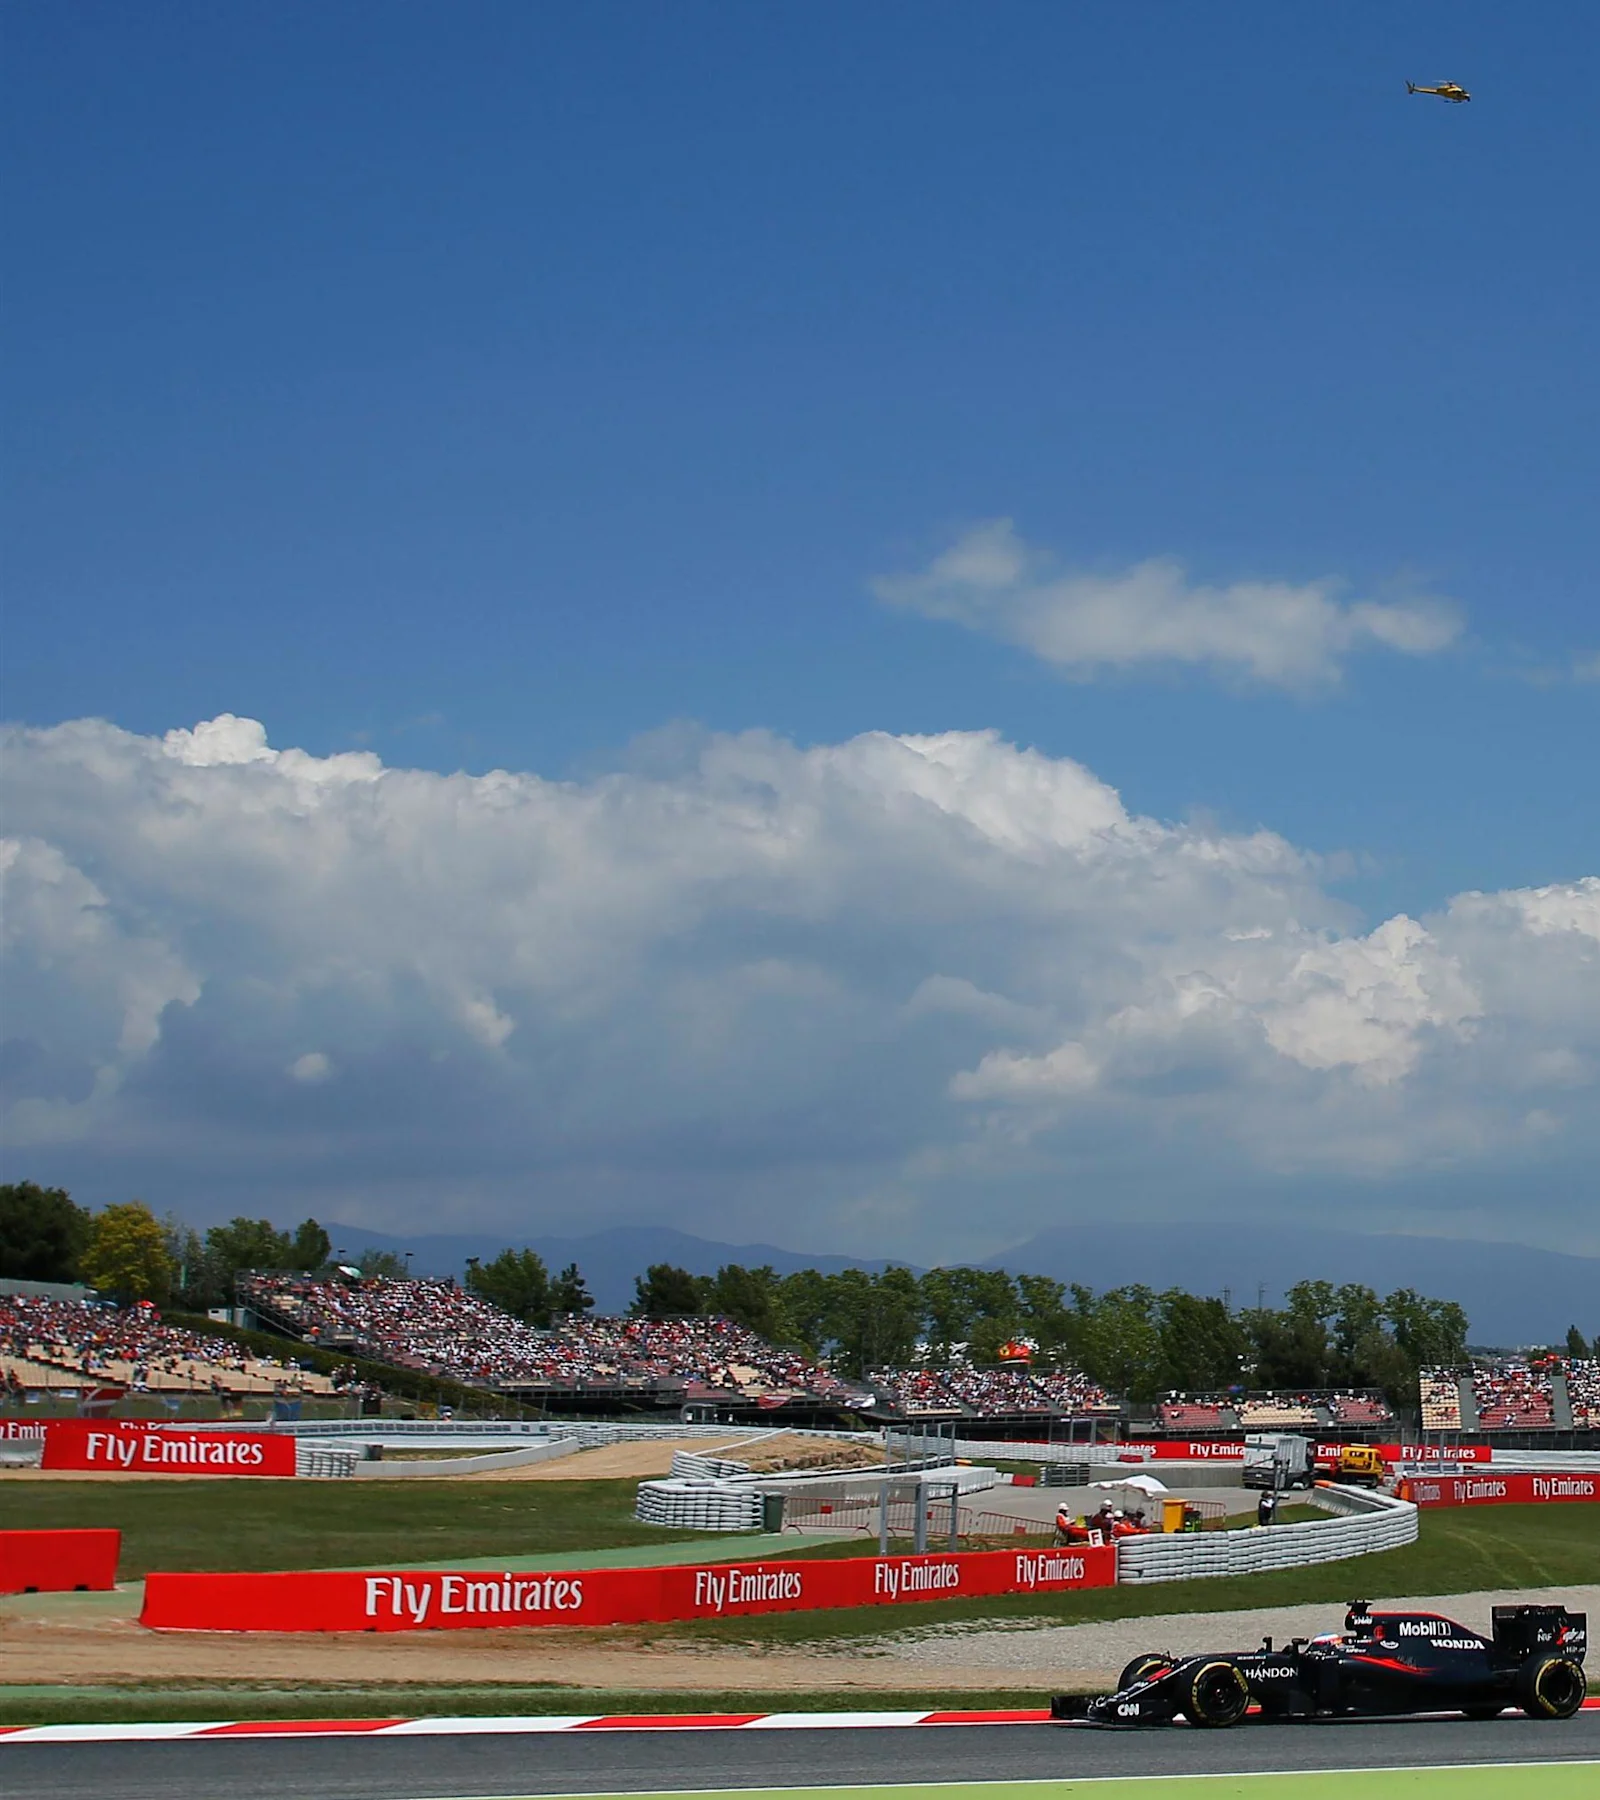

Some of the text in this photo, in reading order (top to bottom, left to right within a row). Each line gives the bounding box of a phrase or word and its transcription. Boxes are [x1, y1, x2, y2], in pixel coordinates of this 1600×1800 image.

[87, 1432, 264, 1467] Fly Emirates
[1189, 1443, 1210, 1457] Fly
[1402, 1446, 1423, 1460] Fly
[1454, 1478, 1506, 1503] Fly Emirates
[1533, 1477, 1594, 1498] Fly Emirates
[1091, 1532, 1100, 1545] F
[874, 1559, 959, 1599] Fly Emirates
[1016, 1553, 1085, 1588] Fly Emirates
[365, 1572, 583, 1623] Fly Emirates
[695, 1567, 801, 1611] Fly Emirates
[1399, 1621, 1436, 1636] Mobil
[1430, 1639, 1485, 1650] HONDA
[1243, 1661, 1298, 1682] HANDON
[1117, 1703, 1139, 1716] CNN
